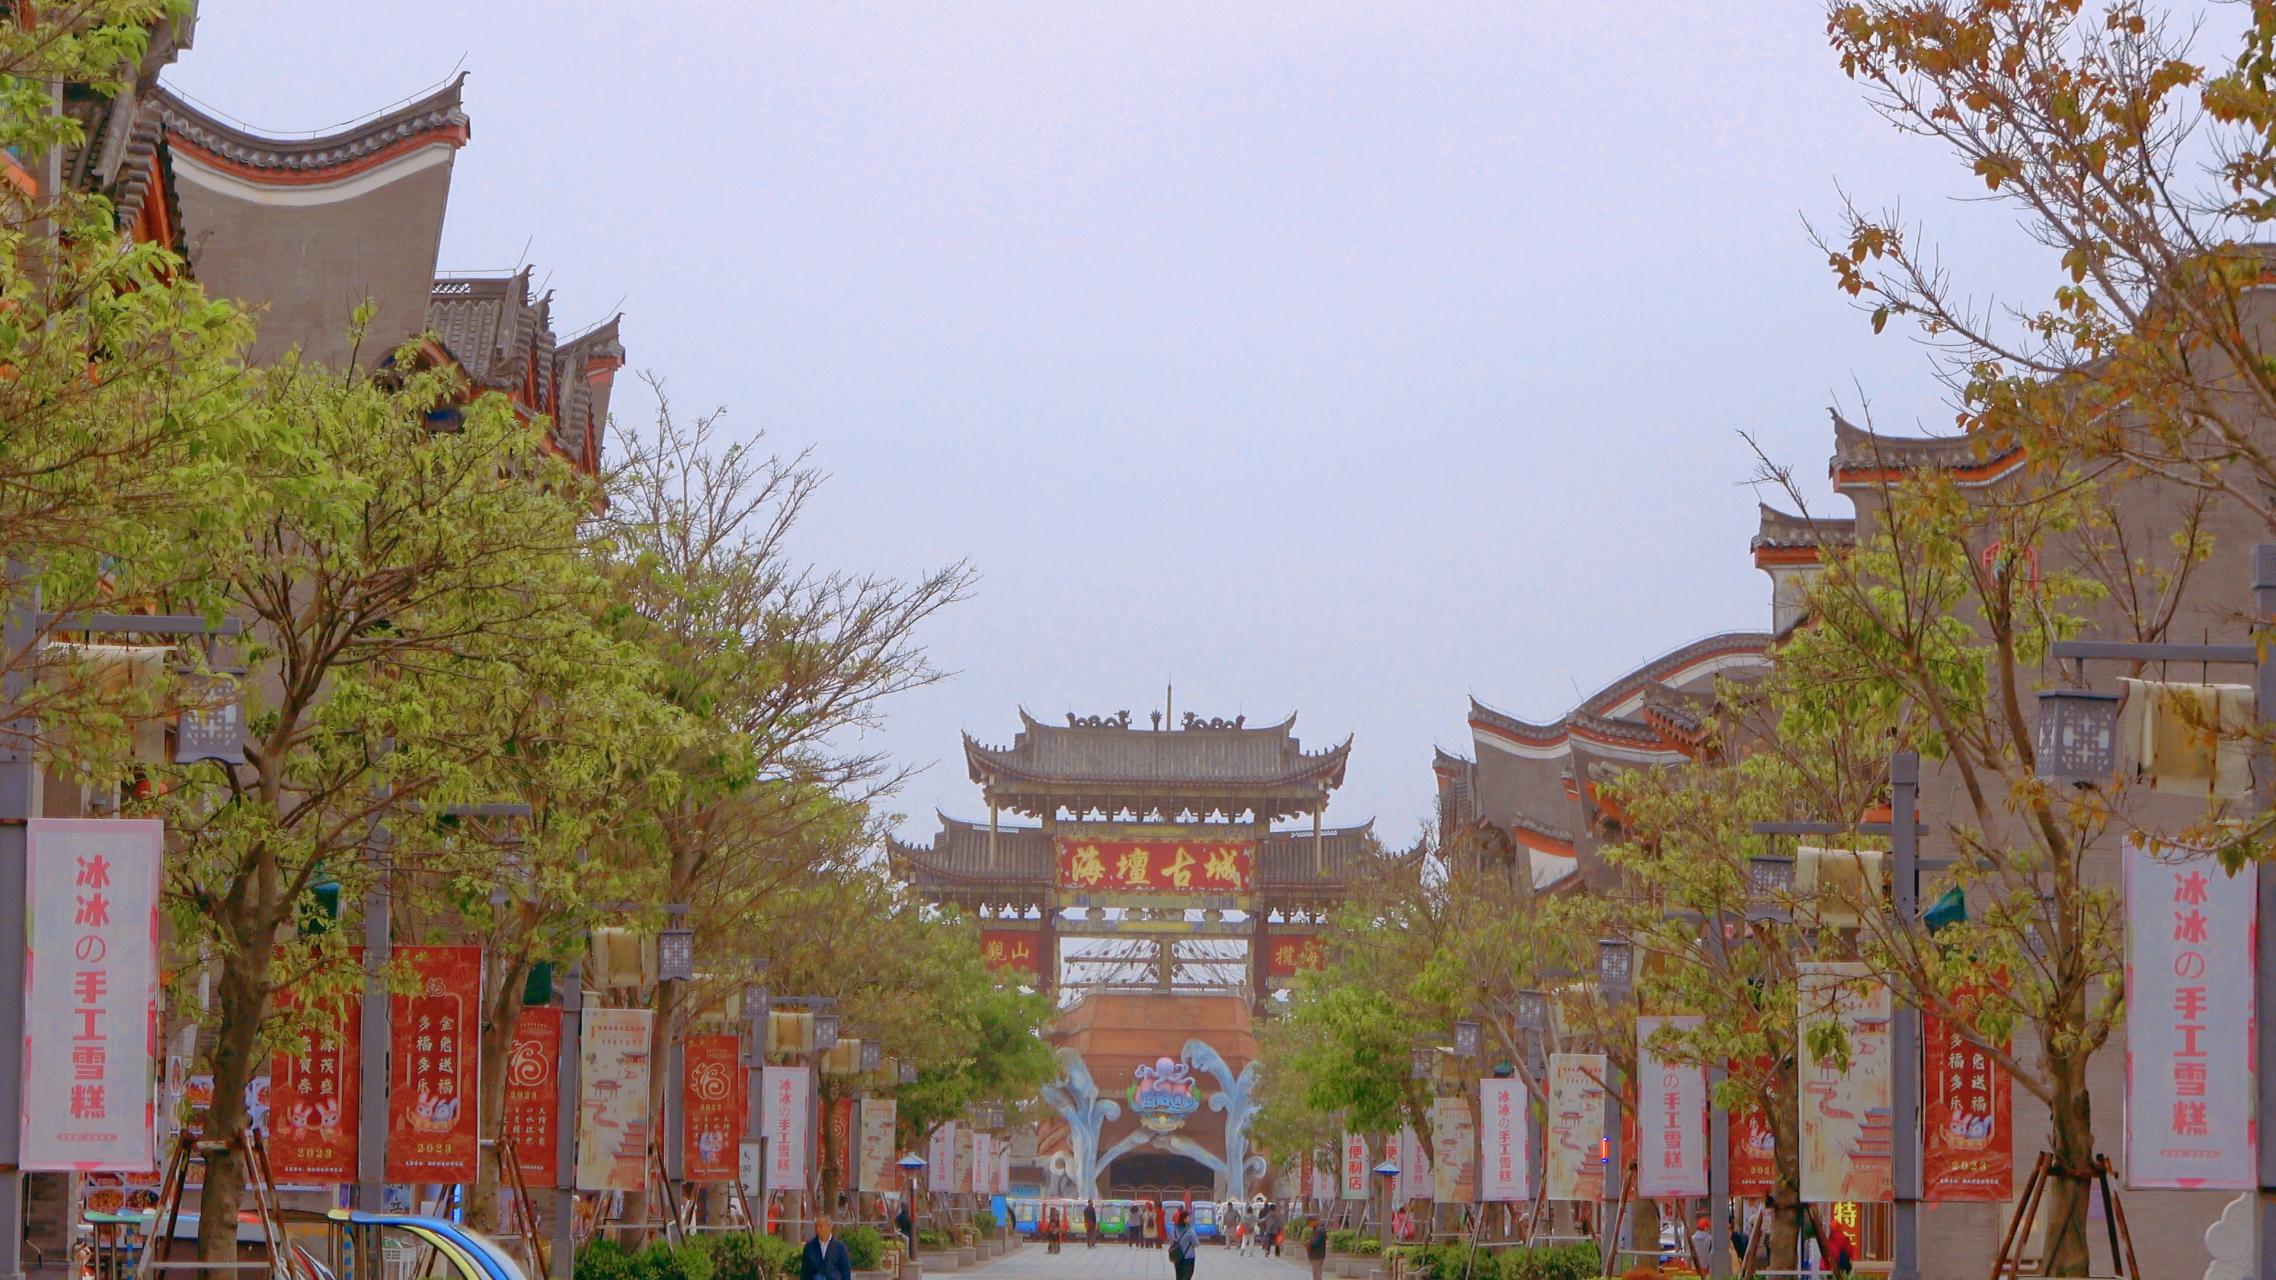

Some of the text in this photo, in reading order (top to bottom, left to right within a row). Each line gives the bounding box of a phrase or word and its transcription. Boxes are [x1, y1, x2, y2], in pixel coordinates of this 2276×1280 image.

[1071, 845, 1242, 887] 海壇古城
[70, 854, 111, 1119] 冰冰の手工雪糕
[2171, 870, 2209, 1136] 冰冰の手工雪糕
[415, 1014, 433, 1093] 多福多乐
[1948, 1033, 1965, 1110] 多福多乐
[510, 1091, 537, 1099] 2023
[777, 1078, 793, 1171] 冰冰の手工雪糕
[297, 1148, 333, 1158] 2023
[417, 1143, 452, 1154] 2023
[1498, 1090, 1512, 1182] 冰冰の手工雪糕
[1951, 1160, 1987, 1171] 2023
[1348, 1145, 1363, 1191] 便利店
